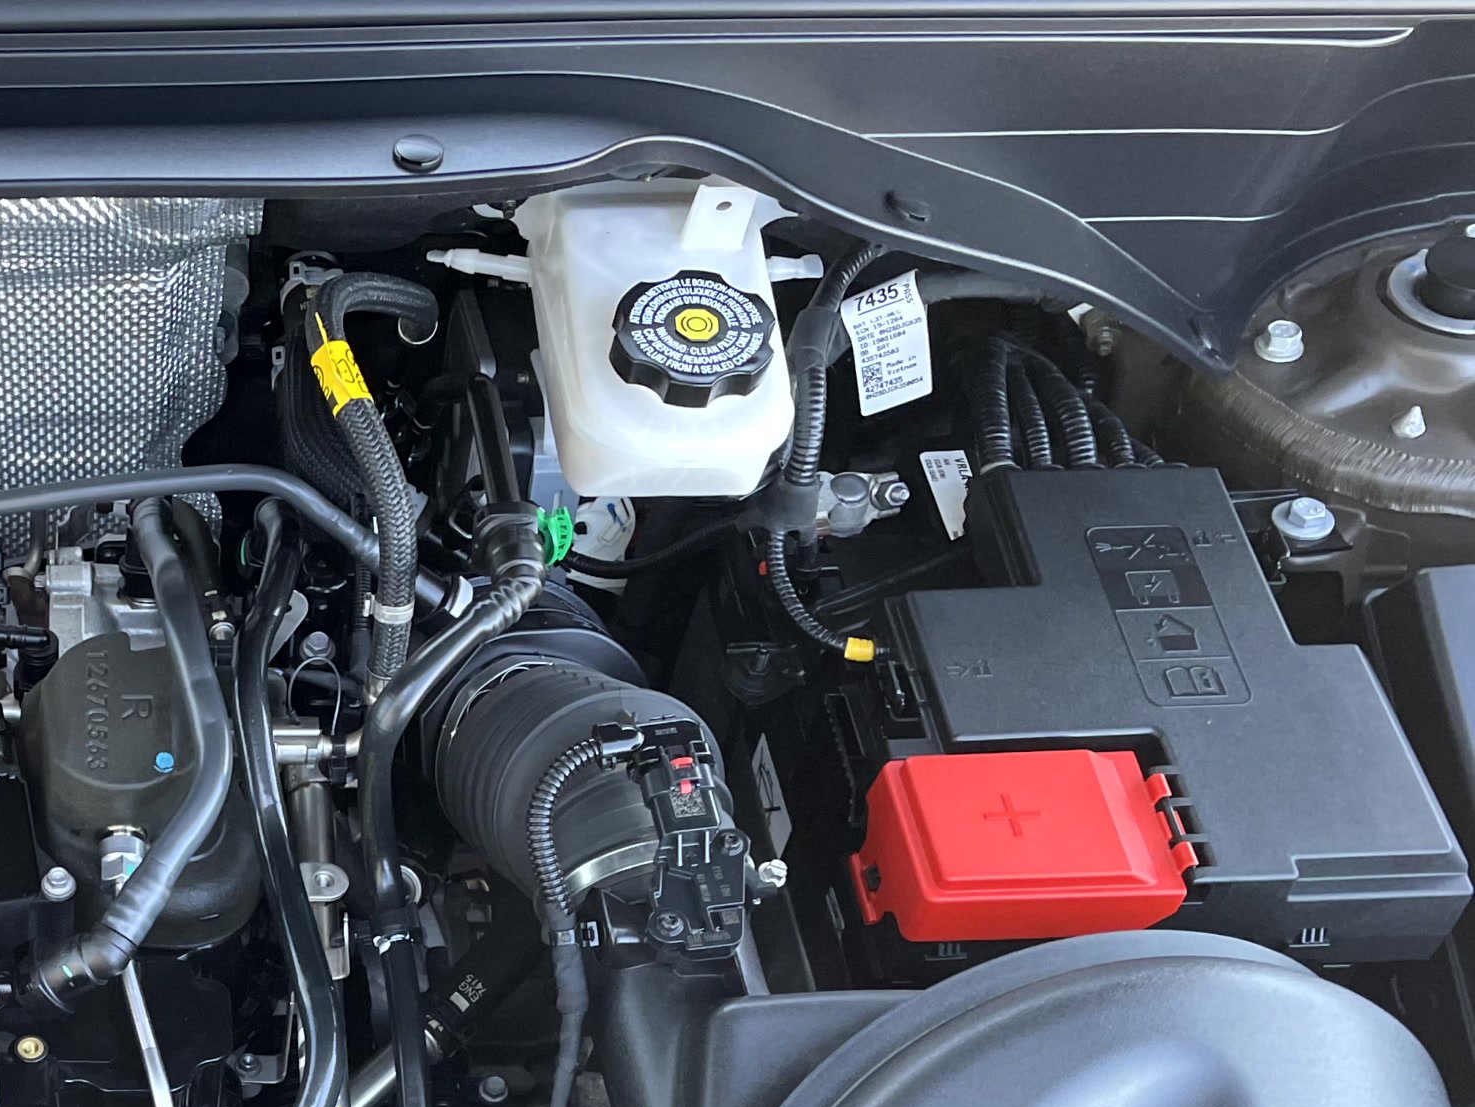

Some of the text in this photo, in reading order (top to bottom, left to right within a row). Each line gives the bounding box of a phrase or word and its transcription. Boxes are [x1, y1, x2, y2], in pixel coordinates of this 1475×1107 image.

[681, 278, 691, 287] LE
[692, 278, 728, 292] BOUCHON
[854, 283, 899, 311] 7435
[652, 340, 683, 361] BEFORE
[682, 353, 728, 364] REMOVING
[690, 345, 720, 355] CLEAN
[665, 359, 692, 373] FROM
[693, 365, 700, 374] A
[700, 360, 735, 375] SEALED
[121, 693, 154, 720] R
